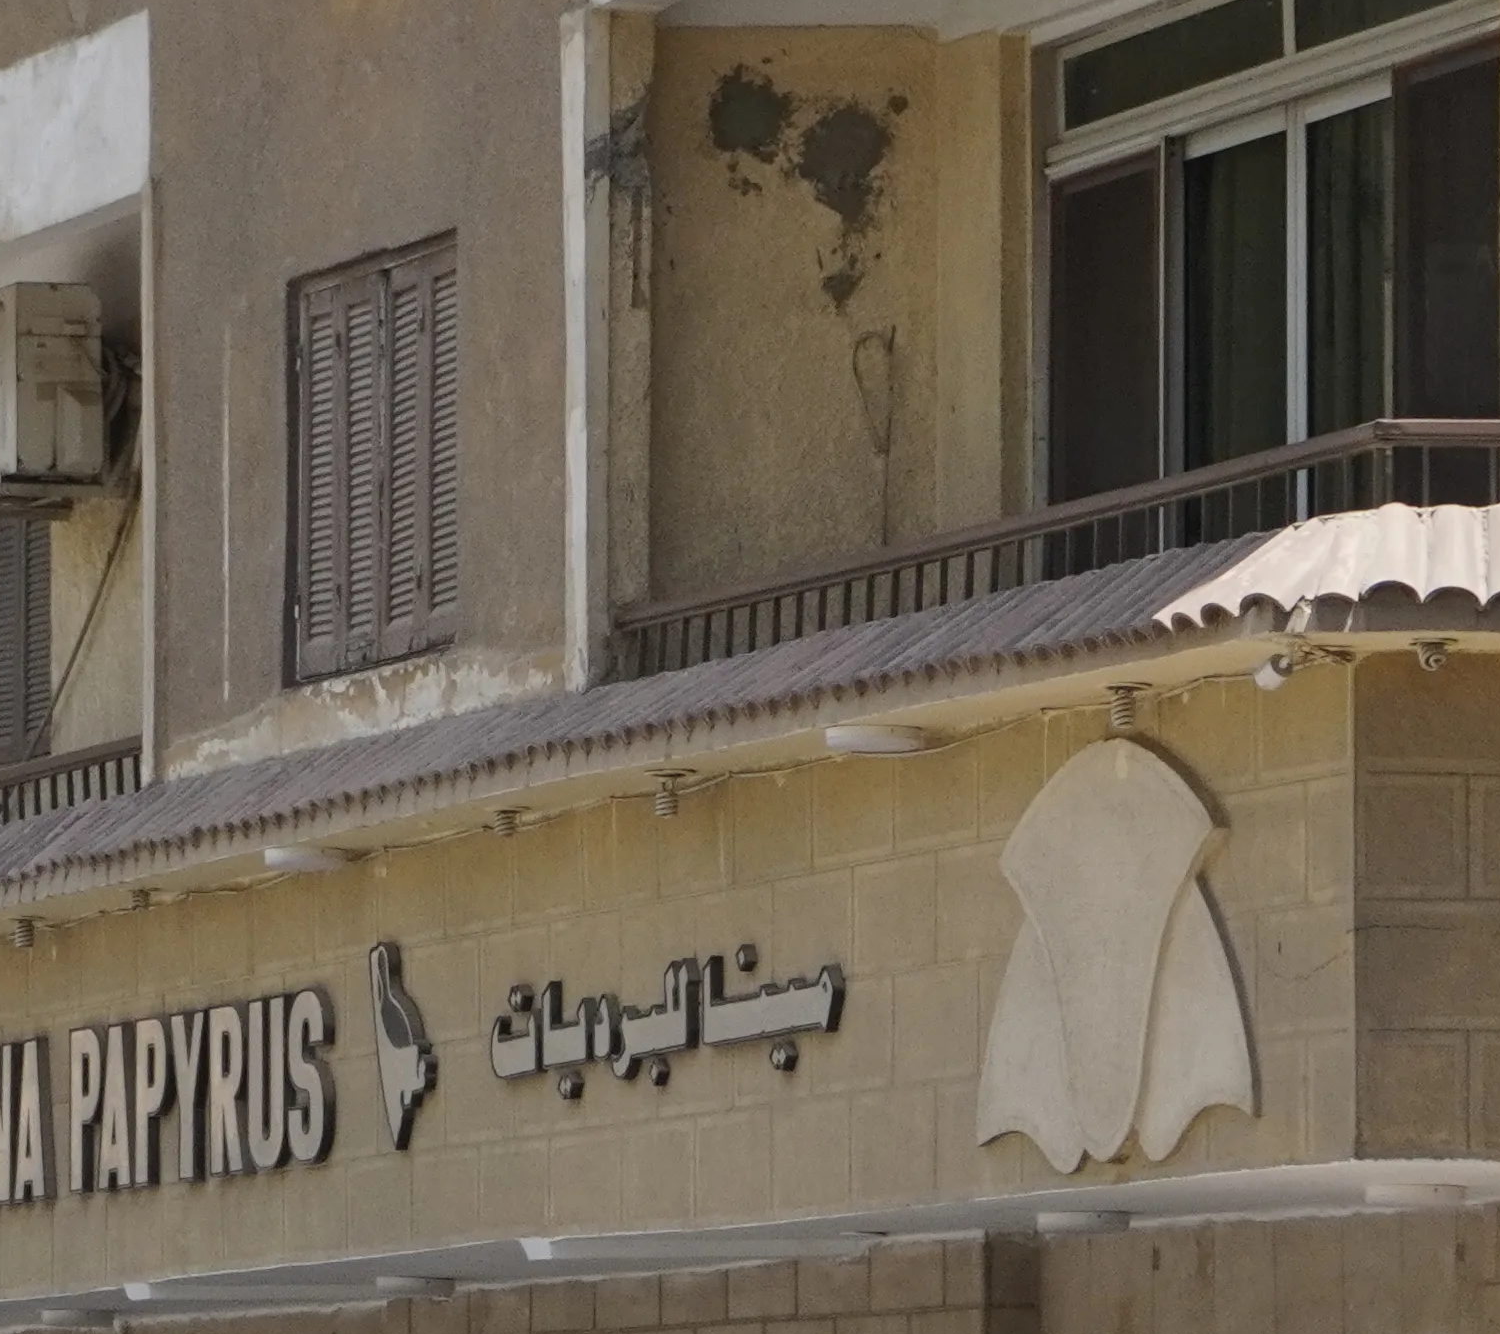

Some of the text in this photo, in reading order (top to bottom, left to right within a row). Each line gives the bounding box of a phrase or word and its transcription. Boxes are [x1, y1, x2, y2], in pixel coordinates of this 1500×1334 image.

[69, 990, 333, 1192] PAPYRUS
[491, 944, 845, 1099] مينا للبرديات
